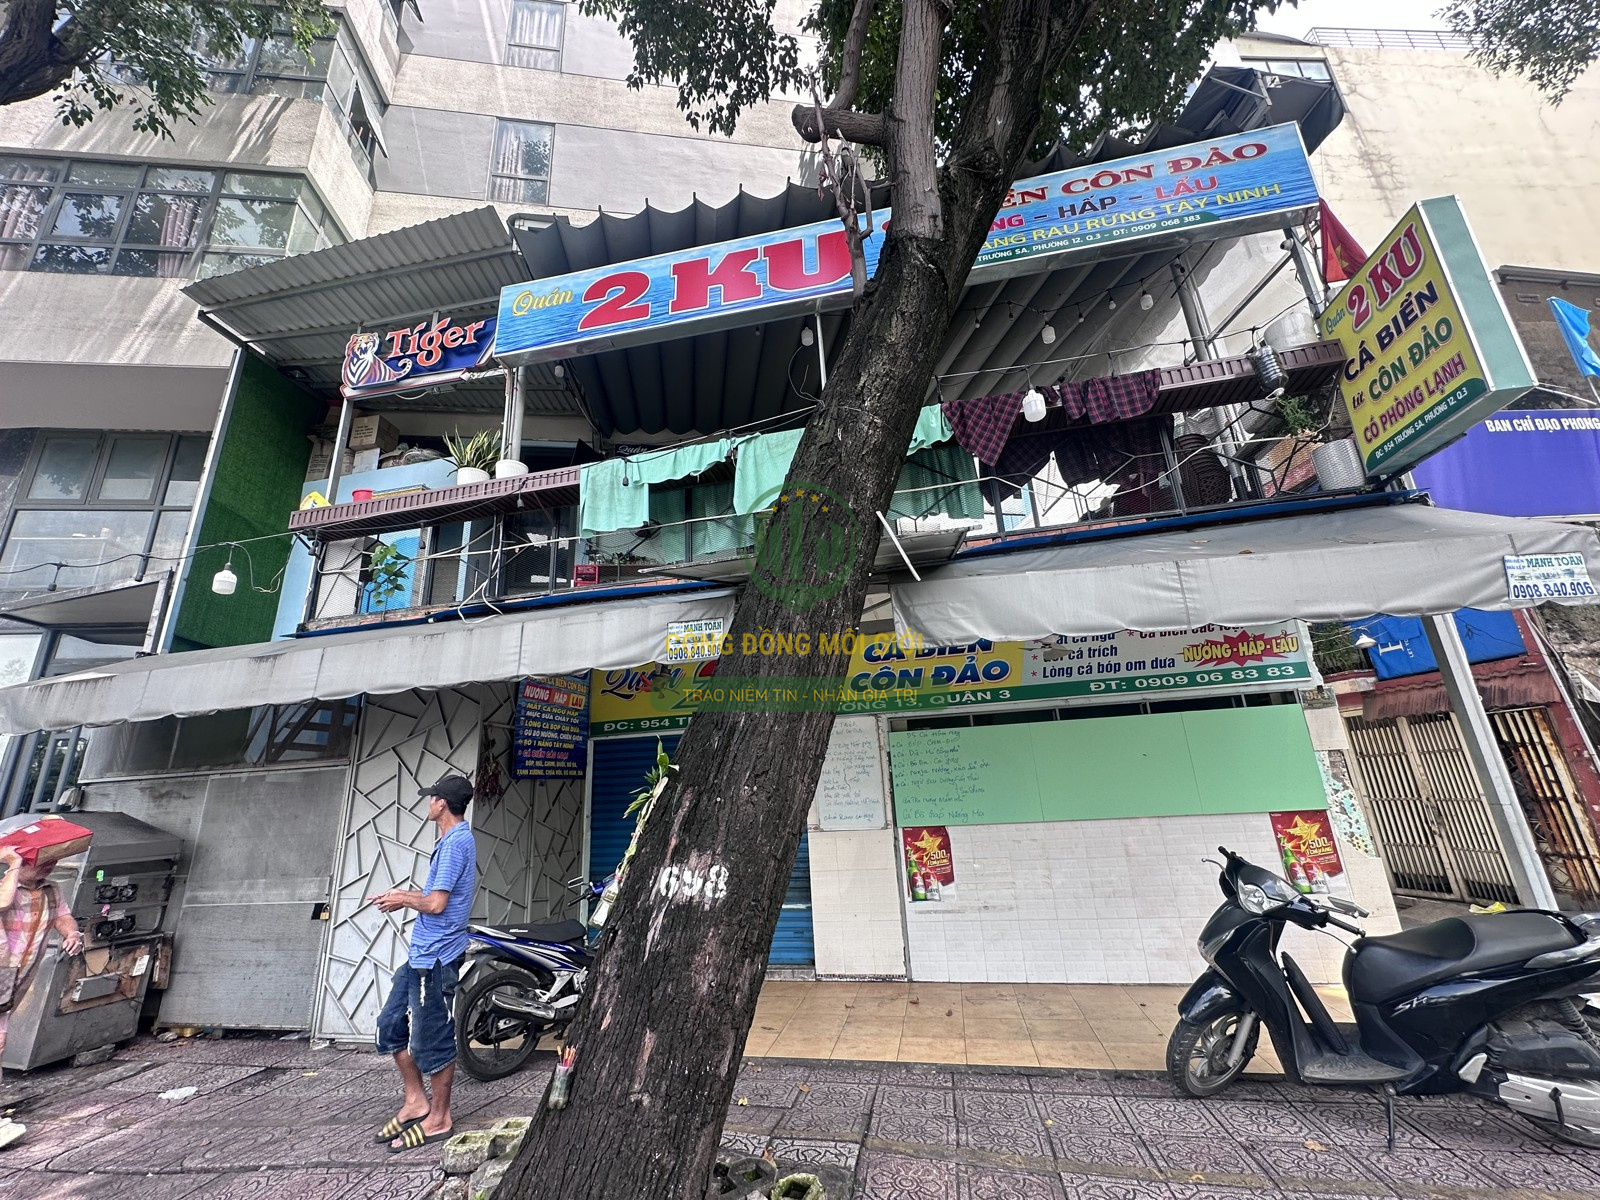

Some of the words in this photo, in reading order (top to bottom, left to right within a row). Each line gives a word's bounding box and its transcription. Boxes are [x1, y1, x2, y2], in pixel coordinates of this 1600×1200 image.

[1061, 165, 1155, 196] CÔN
[1167, 143, 1268, 175] ĐẢO
[1033, 223, 1080, 241] RAU
[1086, 207, 1157, 230] RỪNG
[1162, 195, 1208, 215] TÂY
[1217, 183, 1282, 206] NINH
[1058, 195, 1117, 219] HẤP
[1033, 240, 1070, 252] PHƯỜNG
[1131, 222, 1157, 233] 0909
[1161, 218, 1181, 229] 068
[1183, 214, 1201, 224] 383
[512, 289, 573, 318] Quán
[577, 271, 652, 332] 2
[669, 231, 855, 314] KU
[1325, 308, 1346, 335] Quán
[1347, 283, 1371, 332] 2
[1367, 223, 1424, 306] KU
[385, 317, 485, 367] Tiger
[1344, 340, 1375, 382] CÁ
[1376, 280, 1439, 353] BIỂN
[1369, 360, 1405, 402] CÔN
[1408, 316, 1453, 371] ĐẢO
[1379, 385, 1424, 433] PHÒNG
[1424, 350, 1468, 396] LẠNH
[1485, 419, 1513, 432] BAN
[1512, 414, 1535, 432] CHỈ
[1534, 418, 1561, 433] ĐẠO
[1512, 581, 1595, 599] 0908.840.906
[1068, 647, 1084, 661] cá
[1087, 645, 1118, 659] trích
[1184, 640, 1231, 662] NƯỚNG
[1272, 630, 1298, 653] LẨU
[850, 665, 926, 695] CÔN
[931, 656, 1011, 686] ĐẢO
[1042, 666, 1073, 678] Lòng
[1077, 662, 1093, 676] cá
[1097, 661, 1121, 674] bóp
[1125, 660, 1146, 669] om
[1150, 657, 1176, 670] dưa
[1090, 680, 1127, 691] ĐT:
[1134, 675, 1188, 688] 0909
[1196, 672, 1224, 683] 06
[1231, 669, 1259, 680] 83
[1267, 665, 1296, 677] 83
[930, 691, 992, 705] QUẬN
[999, 690, 1011, 699] 3
[604, 721, 634, 732] ĐC:
[640, 718, 671, 729] 954
[930, 849, 947, 861] 500
[1308, 836, 1328, 850] 500
